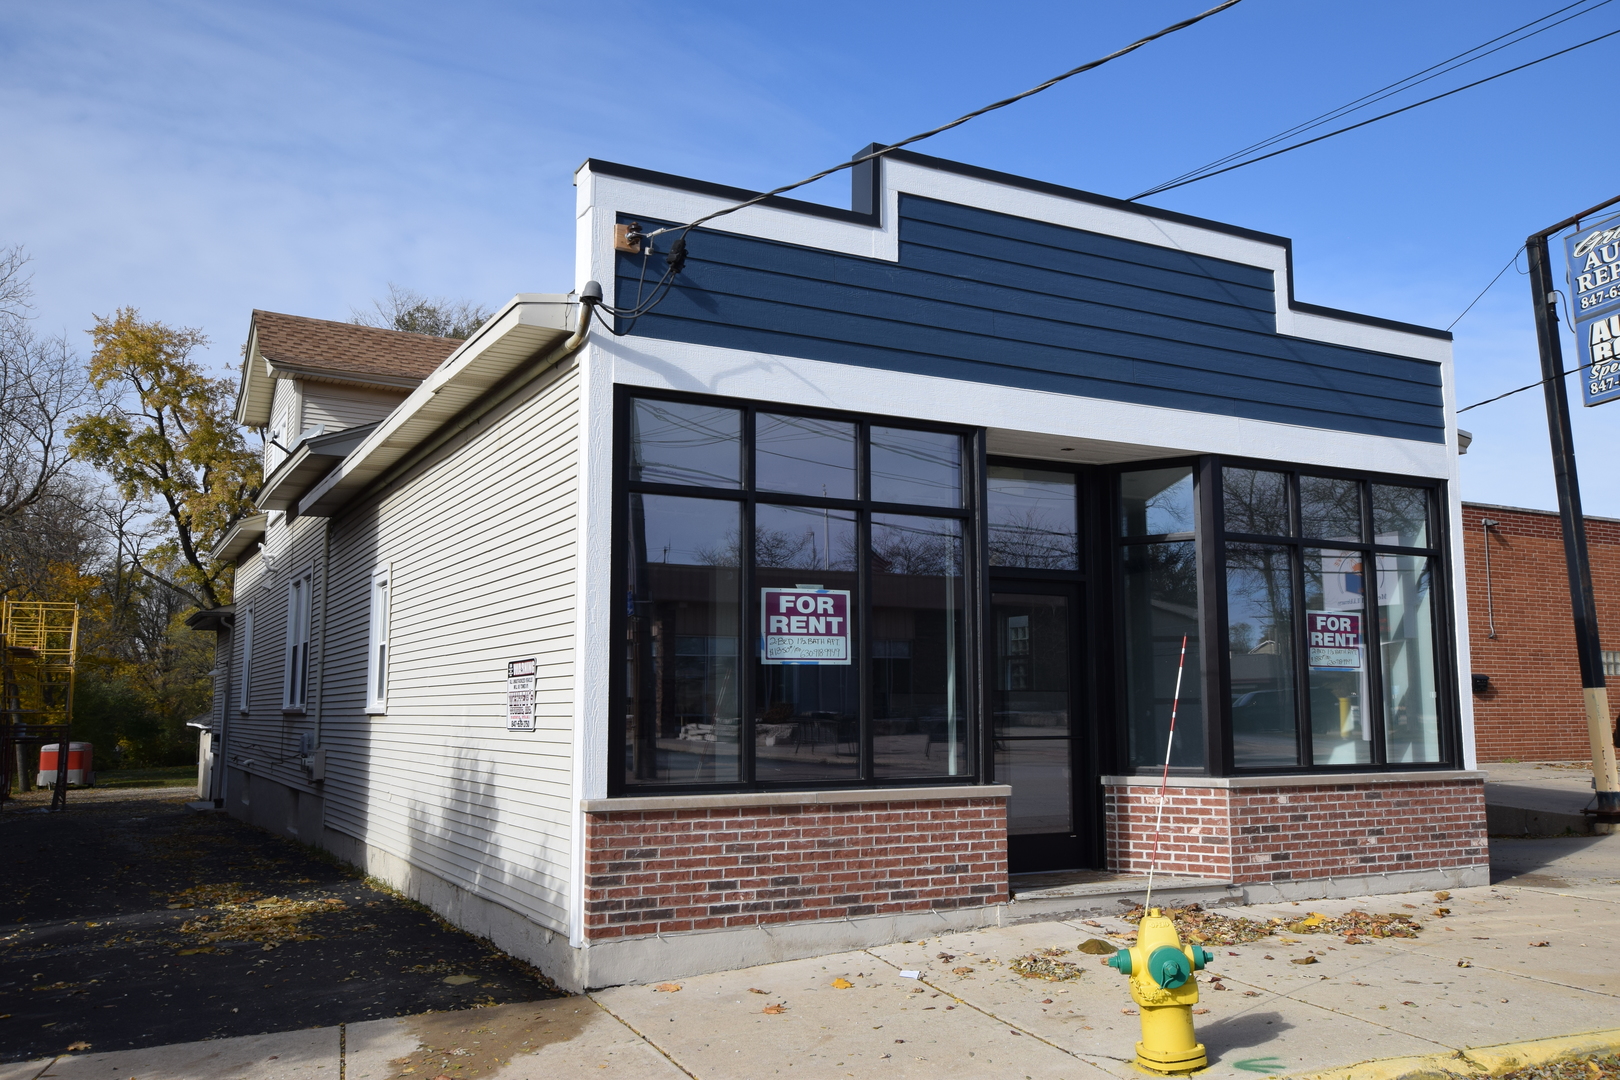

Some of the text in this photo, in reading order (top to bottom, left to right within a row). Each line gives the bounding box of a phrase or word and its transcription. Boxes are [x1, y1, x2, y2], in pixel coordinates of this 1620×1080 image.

[1589, 362, 1620, 381] Spe
[779, 595, 834, 614] FOR
[769, 615, 843, 634] RENT
[1316, 616, 1351, 631] FOR
[1310, 632, 1357, 647] RENT
